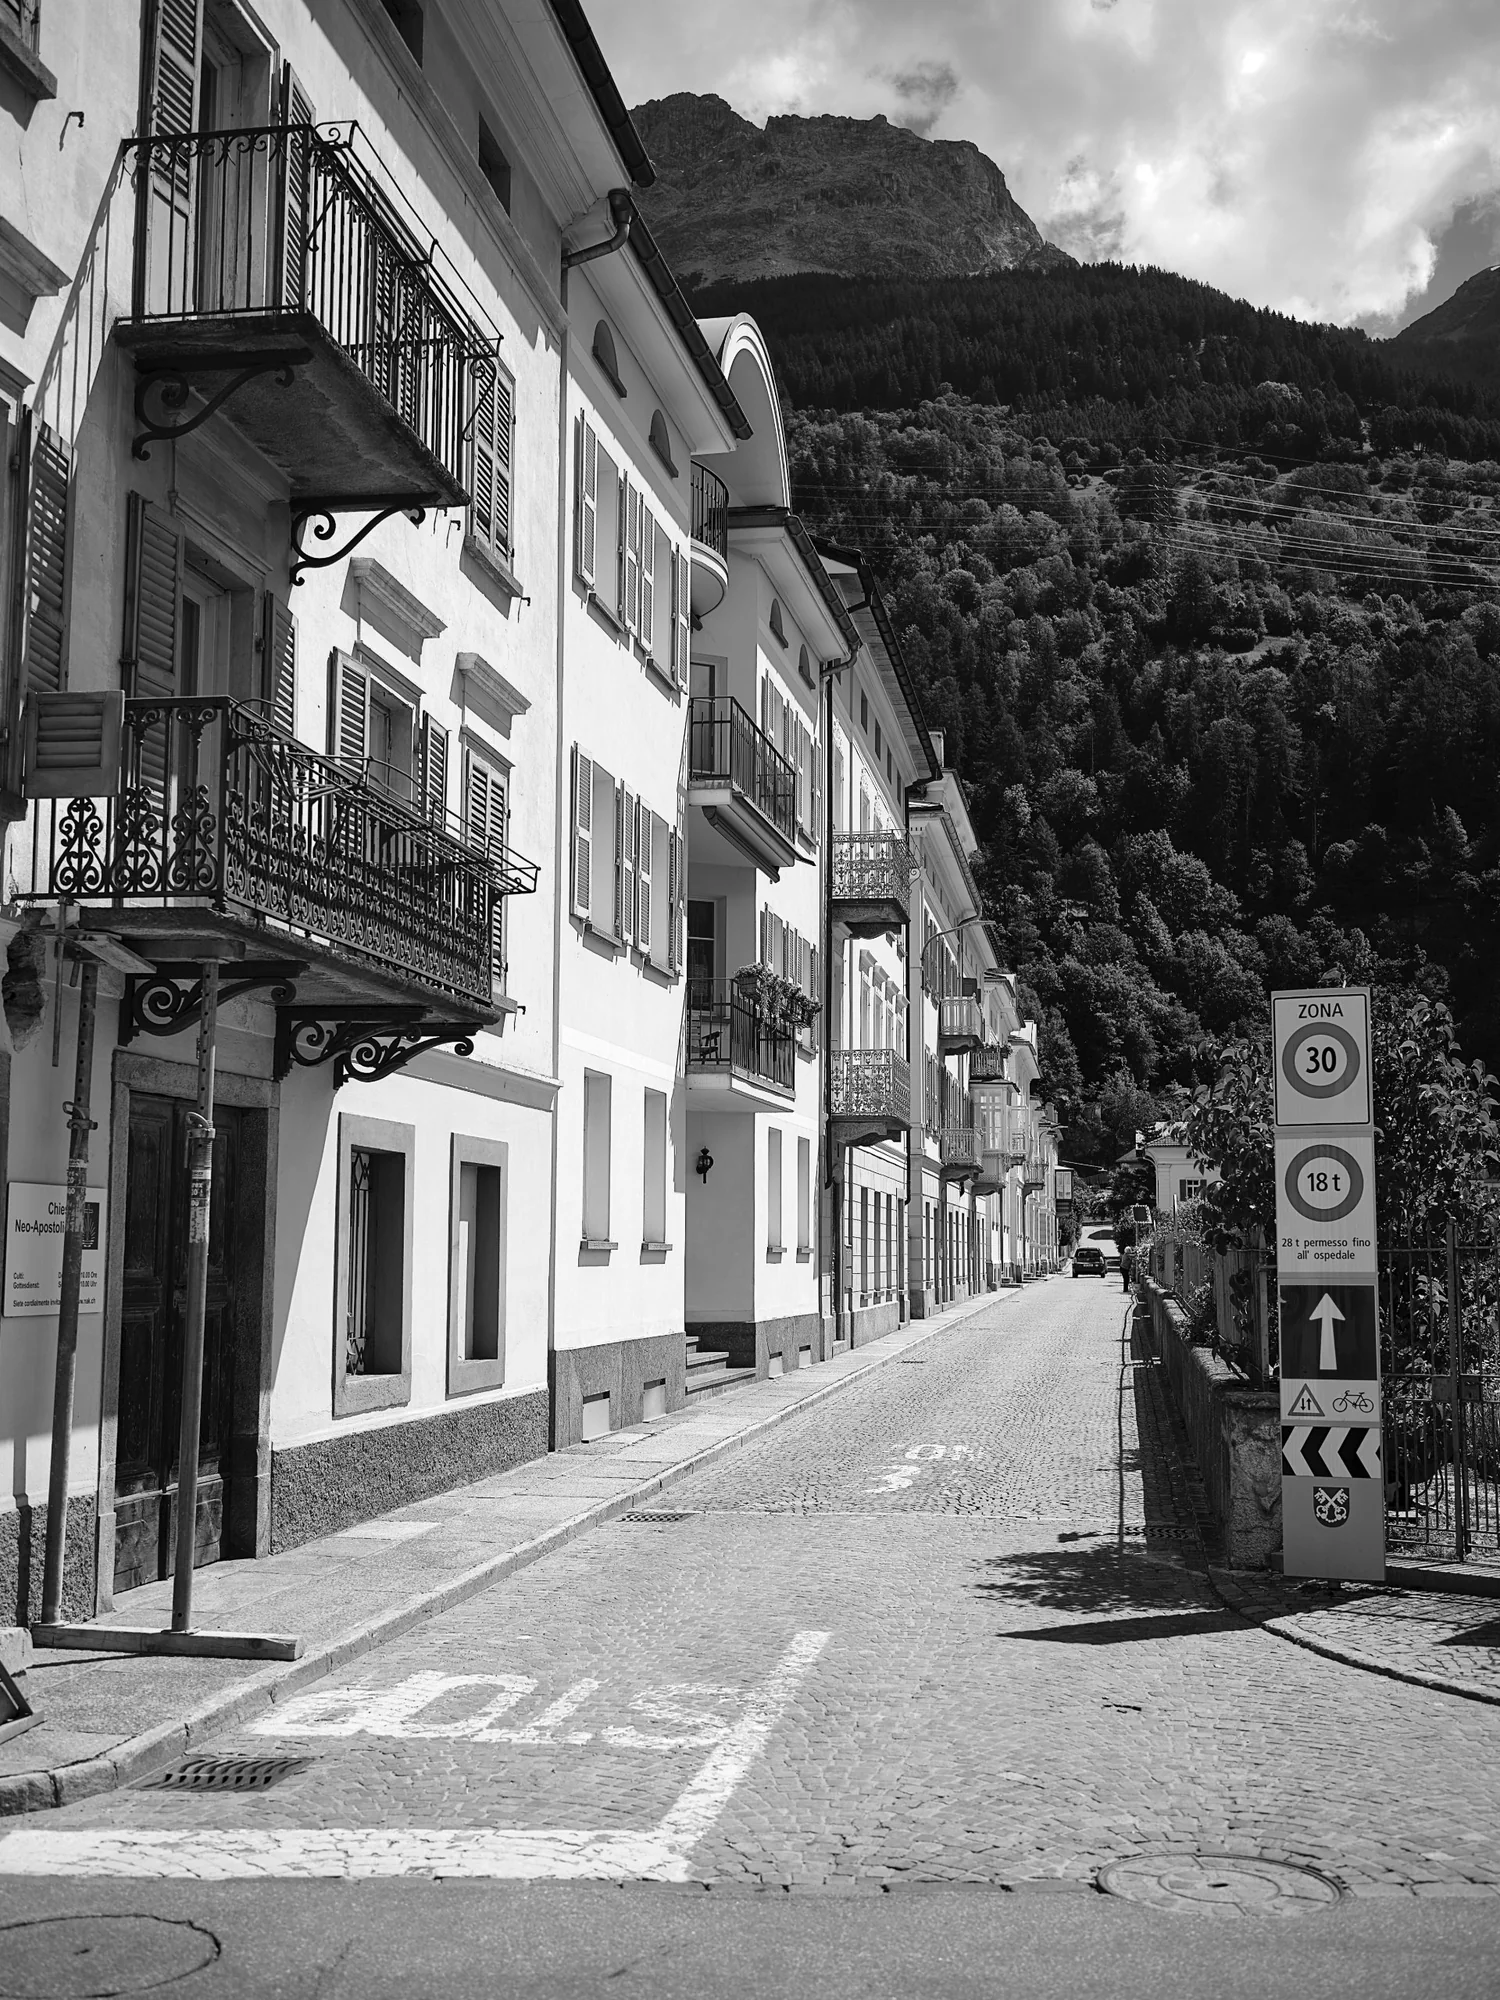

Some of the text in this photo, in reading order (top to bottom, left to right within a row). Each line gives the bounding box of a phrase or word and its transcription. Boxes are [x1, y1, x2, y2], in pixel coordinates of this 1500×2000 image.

[1298, 1003, 1344, 1019] ZONA
[1305, 1046, 1337, 1074] 30
[1307, 1172, 1341, 1192] 18 t
[15, 1219, 65, 1236] Neo-Apostoli
[1281, 1237, 1371, 1249] 28 t permesso fino
[1296, 1250, 1355, 1261] all' ospedale
